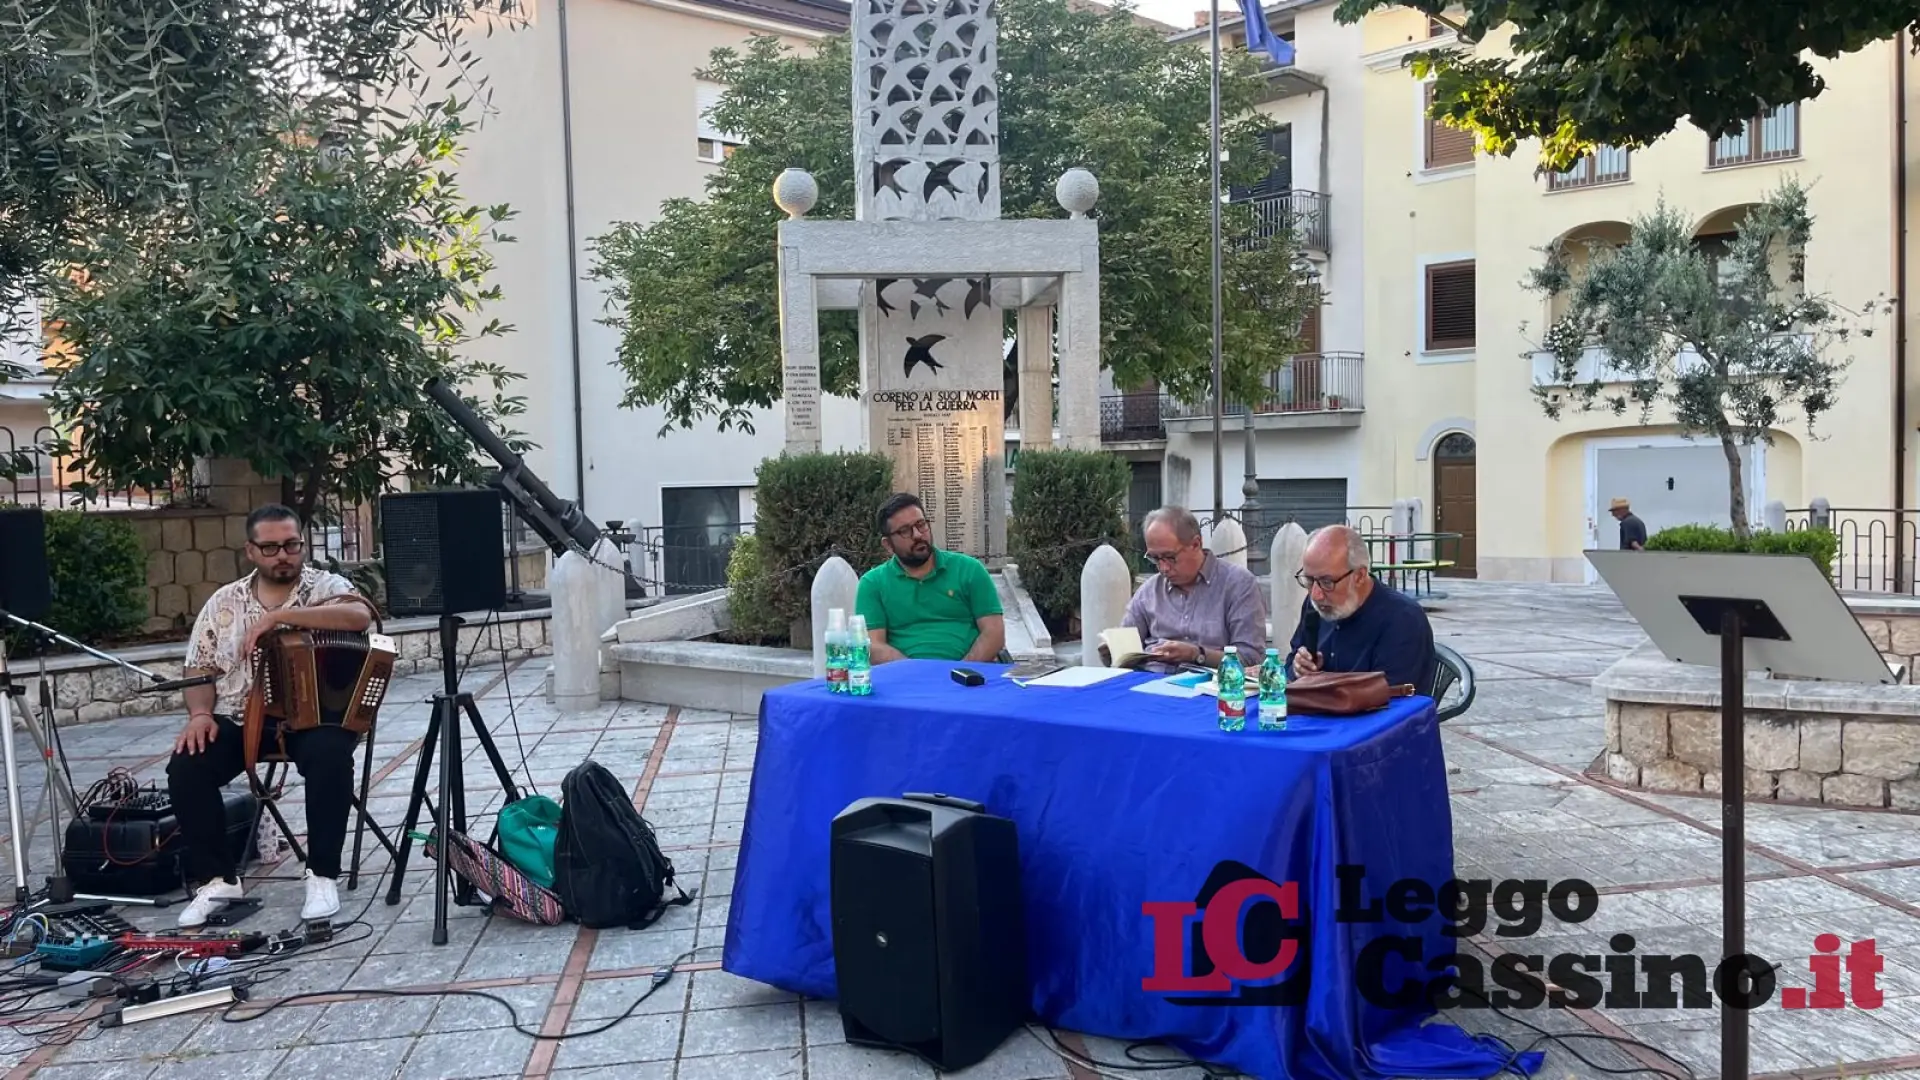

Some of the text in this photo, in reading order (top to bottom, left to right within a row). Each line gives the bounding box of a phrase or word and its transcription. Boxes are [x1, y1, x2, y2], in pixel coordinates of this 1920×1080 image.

[873, 390, 999, 402] CORENO AI SUOI MORTI
[895, 400, 977, 412] PER LA GUERRA
